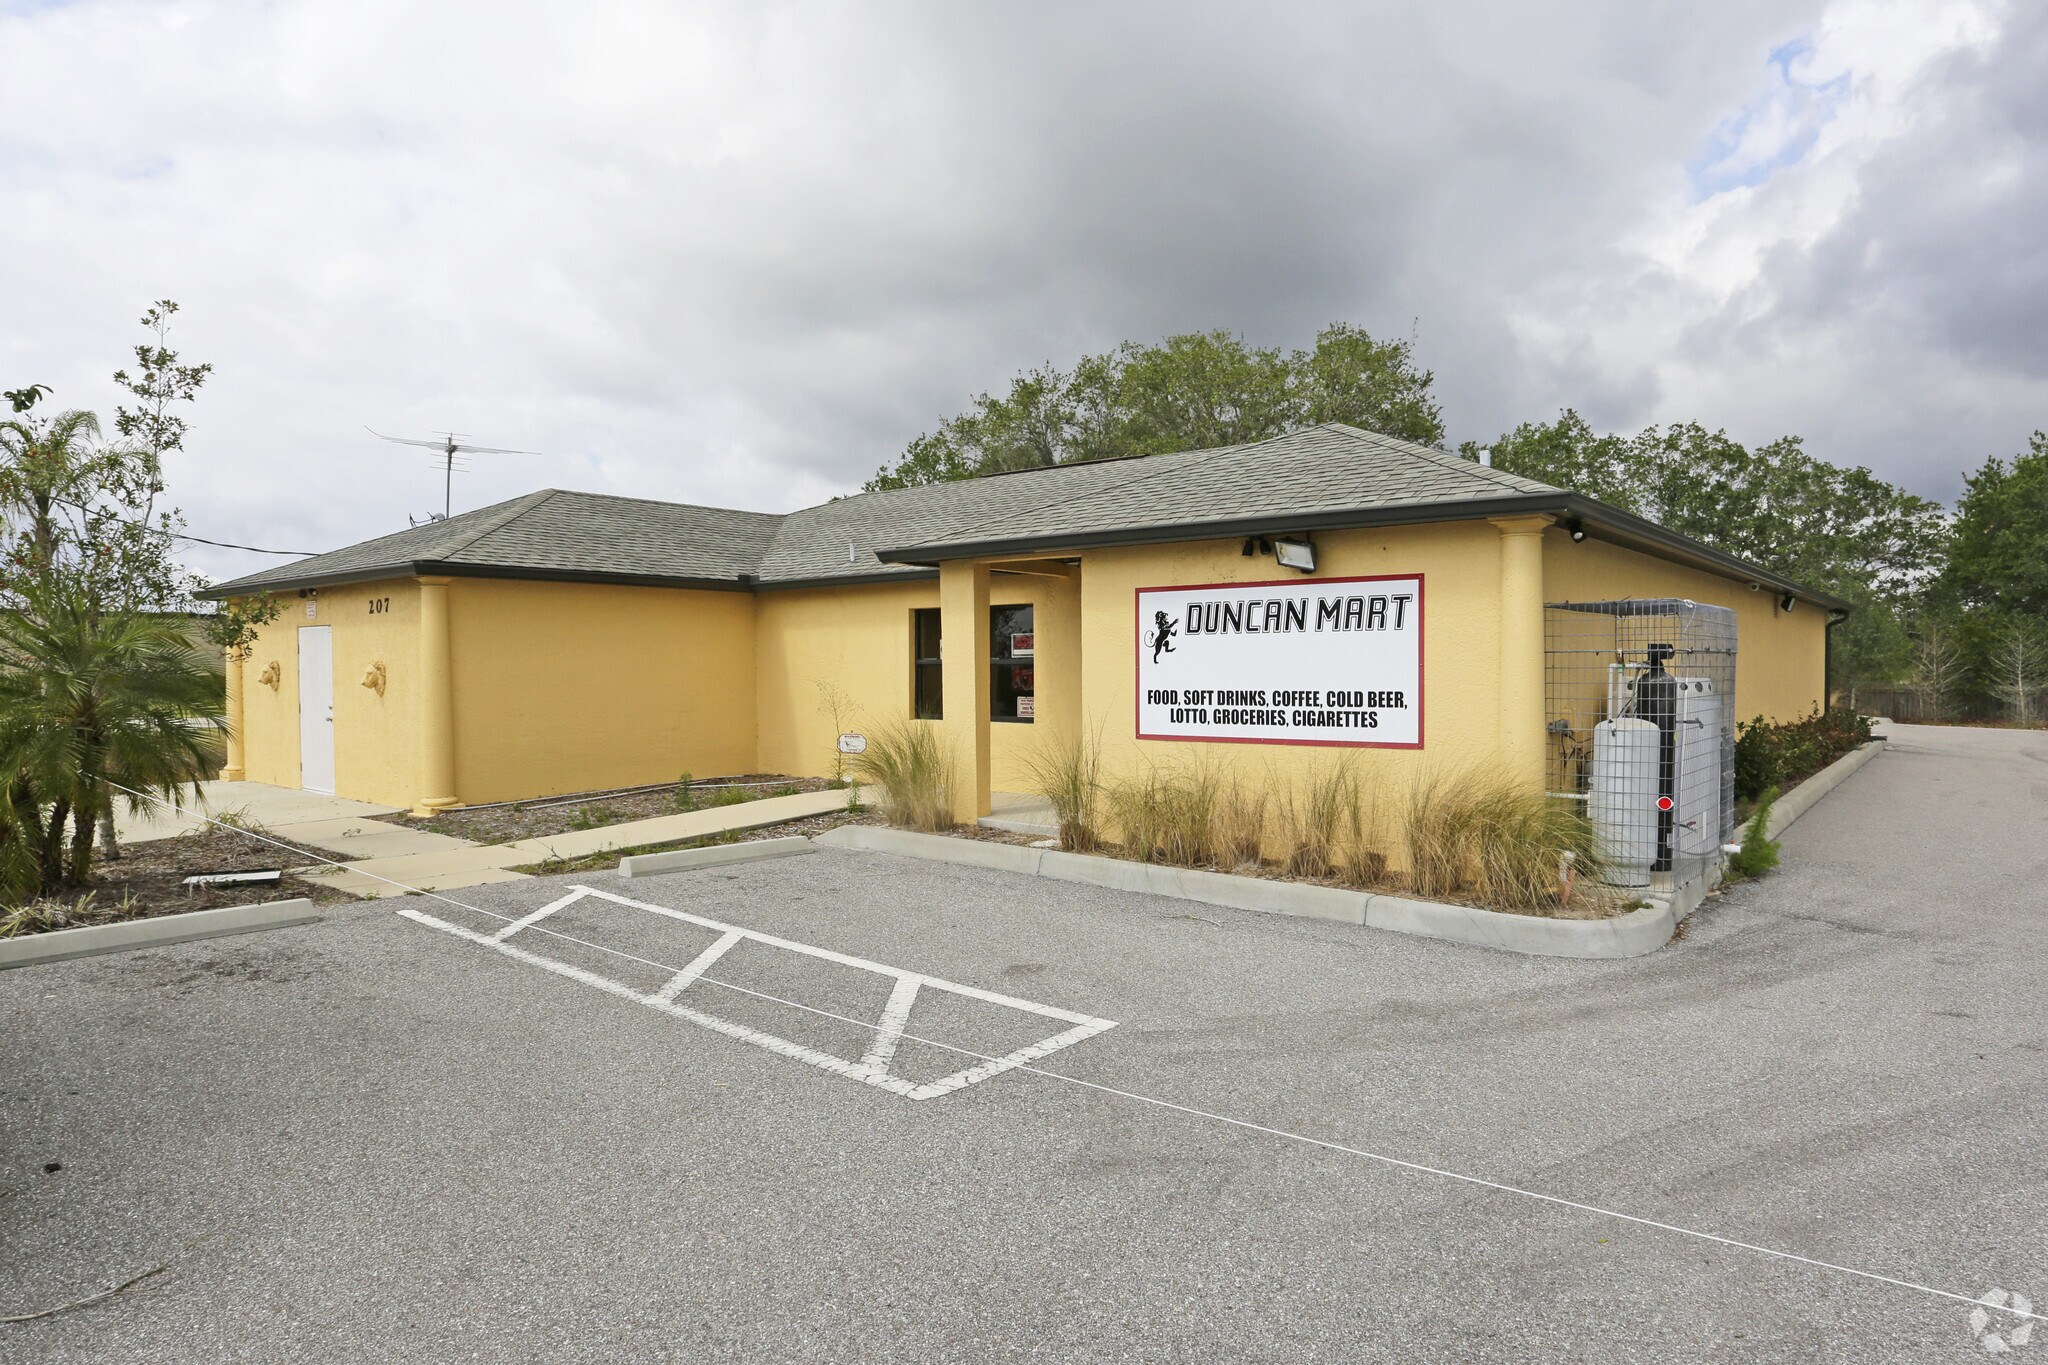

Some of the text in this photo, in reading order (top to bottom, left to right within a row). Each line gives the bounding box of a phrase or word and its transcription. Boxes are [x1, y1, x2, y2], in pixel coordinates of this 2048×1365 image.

[368, 597, 390, 615] 207
[1185, 594, 1413, 635] DUNCAN MART
[1147, 689, 1408, 710] FOOD, SOFT DRINKS, COFFEE, COLD BEER,
[1170, 708, 1378, 728] LOTTO, GROCERIES, CIGARETTES
